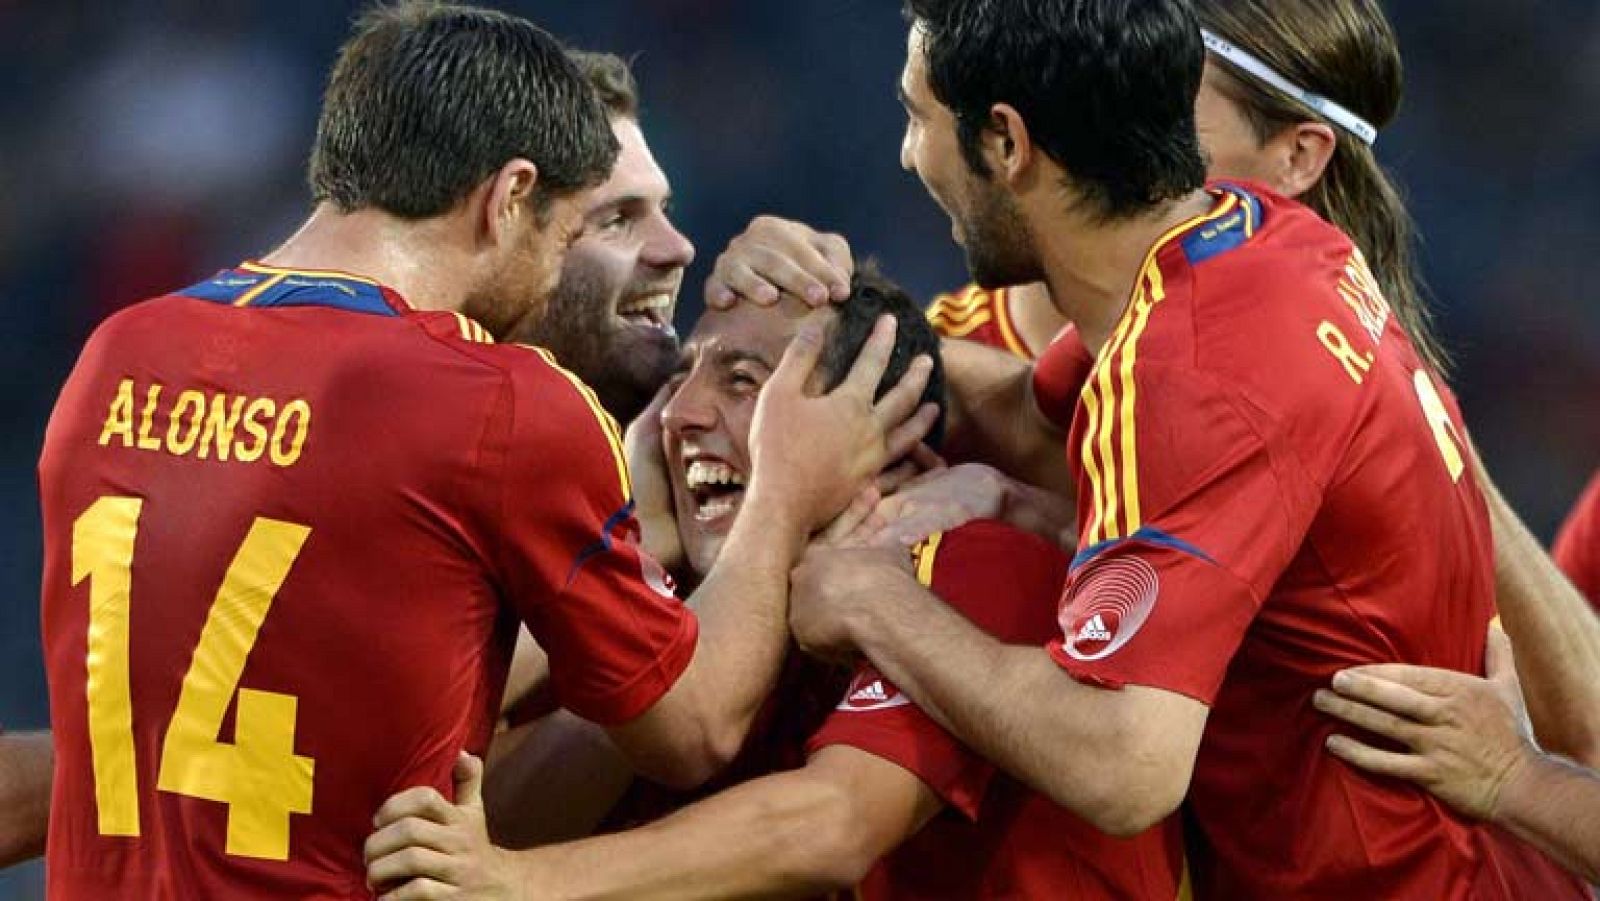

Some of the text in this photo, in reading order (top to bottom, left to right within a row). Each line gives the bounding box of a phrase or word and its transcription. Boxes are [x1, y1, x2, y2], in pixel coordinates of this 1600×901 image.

[1316, 320, 1375, 384] R.
[98, 379, 311, 467] ALONSO
[72, 496, 315, 861] 14
